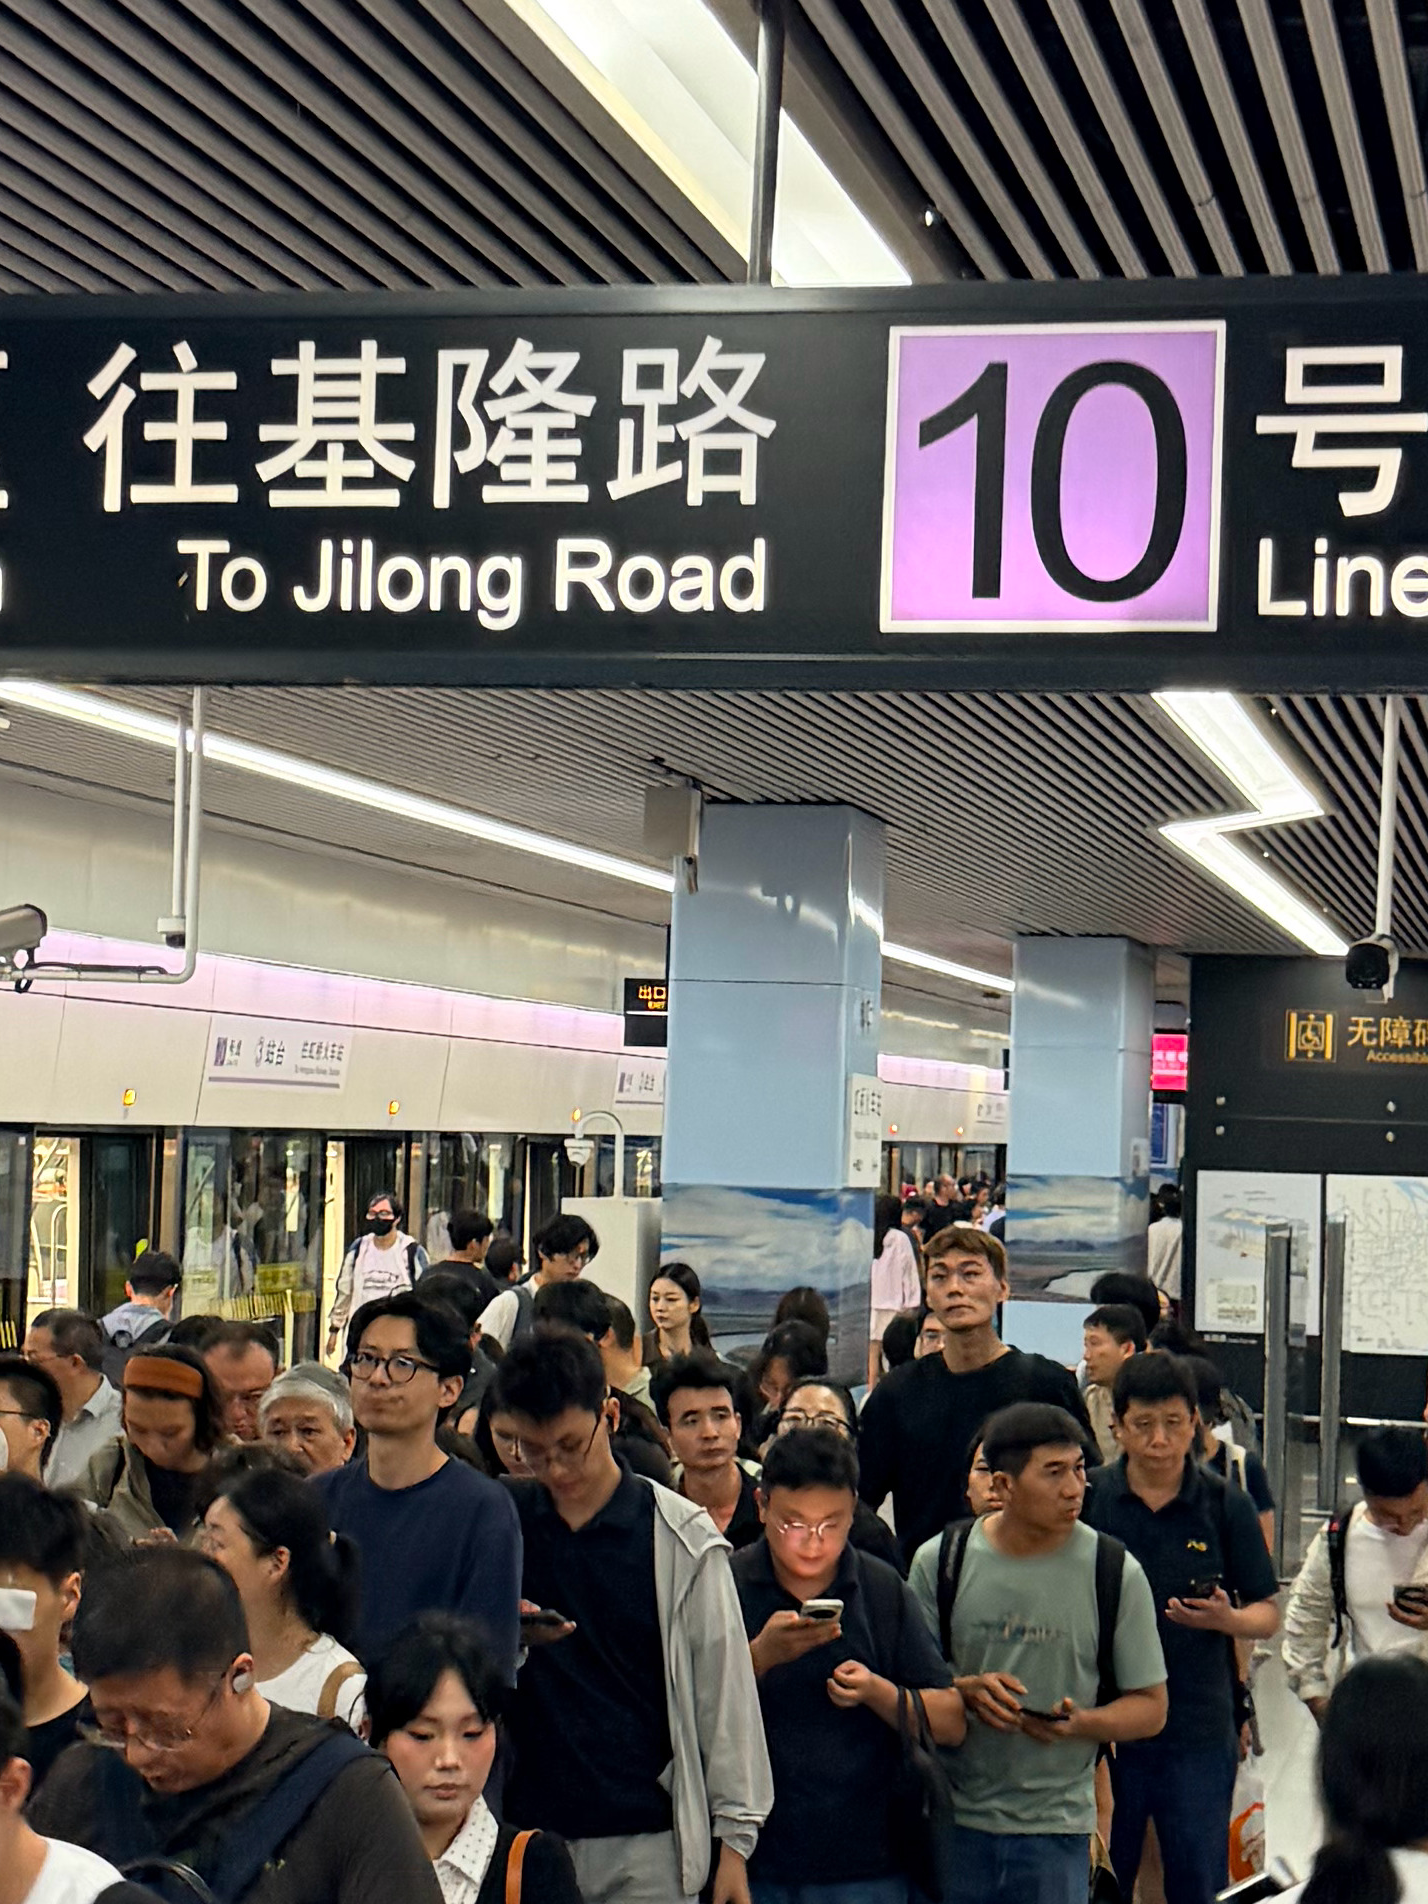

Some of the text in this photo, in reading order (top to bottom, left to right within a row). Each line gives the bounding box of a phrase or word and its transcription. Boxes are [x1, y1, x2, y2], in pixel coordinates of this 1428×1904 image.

[84, 336, 777, 513] 往基隆路
[918, 361, 1188, 603] 10
[178, 539, 767, 631] To Jilong Road
[638, 986, 666, 1000] 出口
